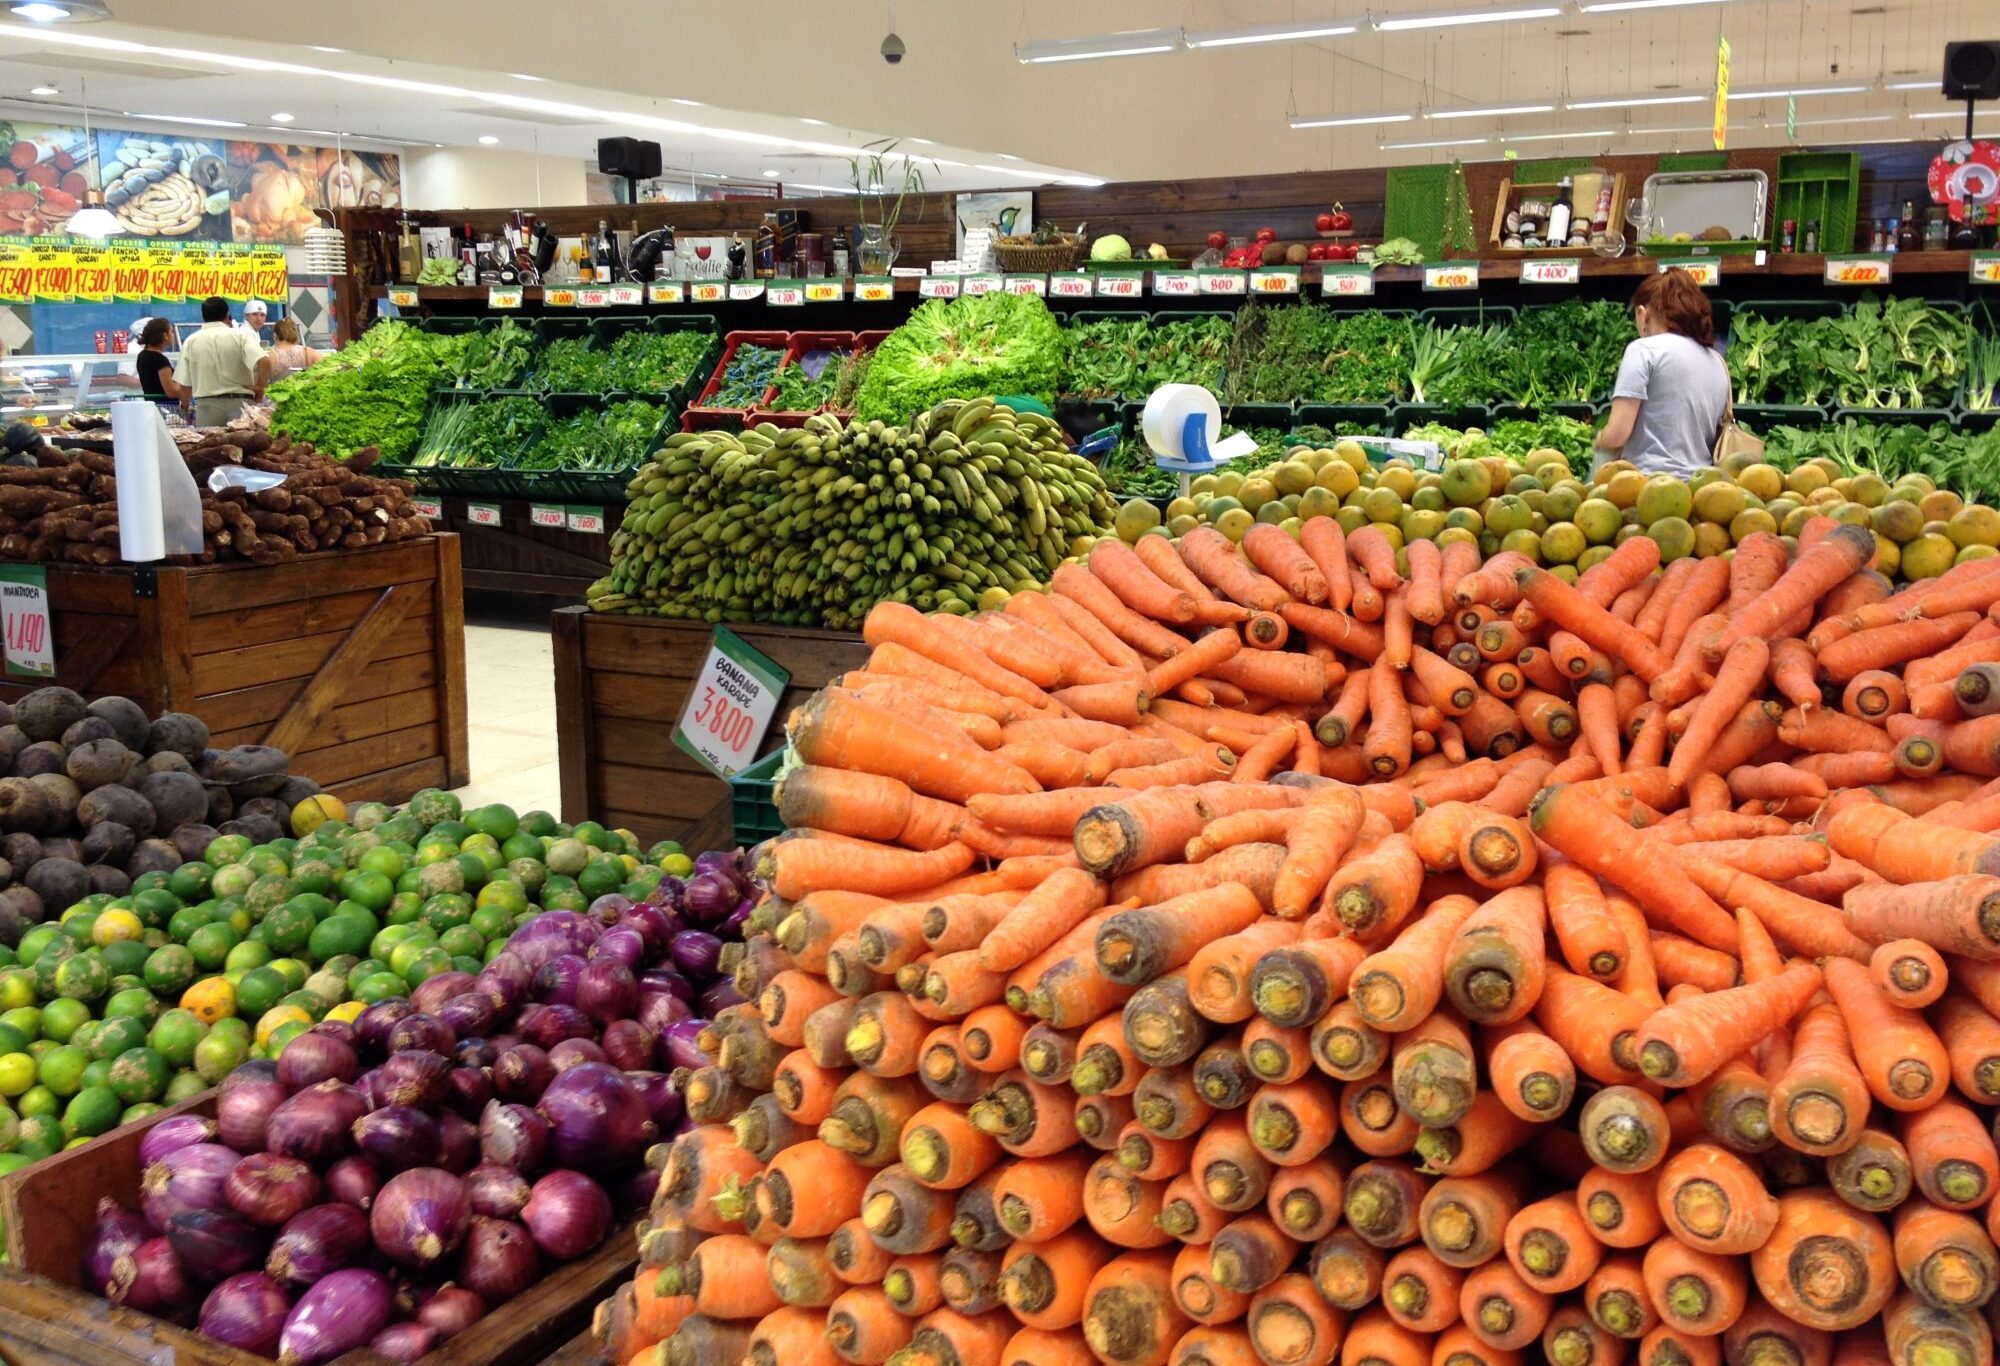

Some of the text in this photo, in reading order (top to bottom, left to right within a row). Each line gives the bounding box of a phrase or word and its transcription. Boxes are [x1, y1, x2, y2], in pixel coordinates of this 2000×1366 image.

[33, 236, 67, 244] OFERTA
[112, 247, 139, 255] PANCHO
[716, 657, 760, 698] BANANA
[716, 675, 752, 708] KARAPE
